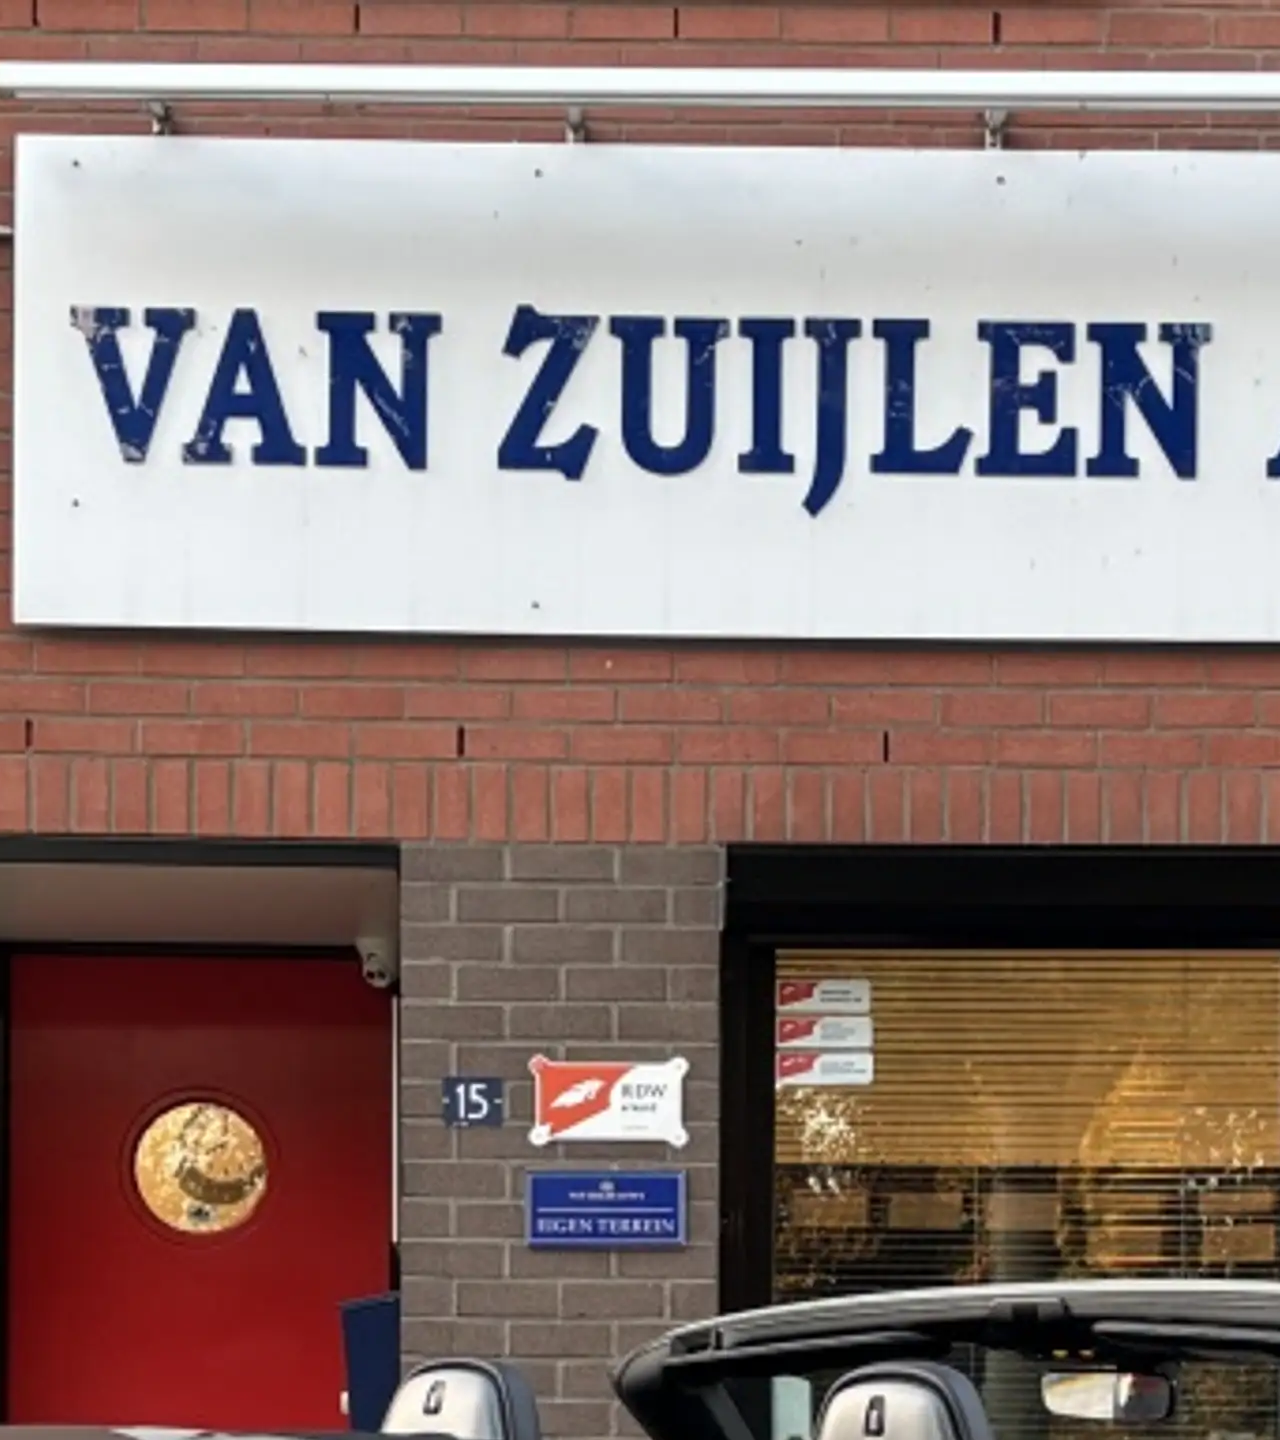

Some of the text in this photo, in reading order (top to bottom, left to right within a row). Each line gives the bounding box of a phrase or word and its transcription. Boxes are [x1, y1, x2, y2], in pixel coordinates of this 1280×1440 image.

[71, 306, 443, 470] VAN
[499, 306, 1212, 516] ZUIJLEN
[455, 1083, 489, 1119] 15
[620, 1083, 668, 1099] RDW
